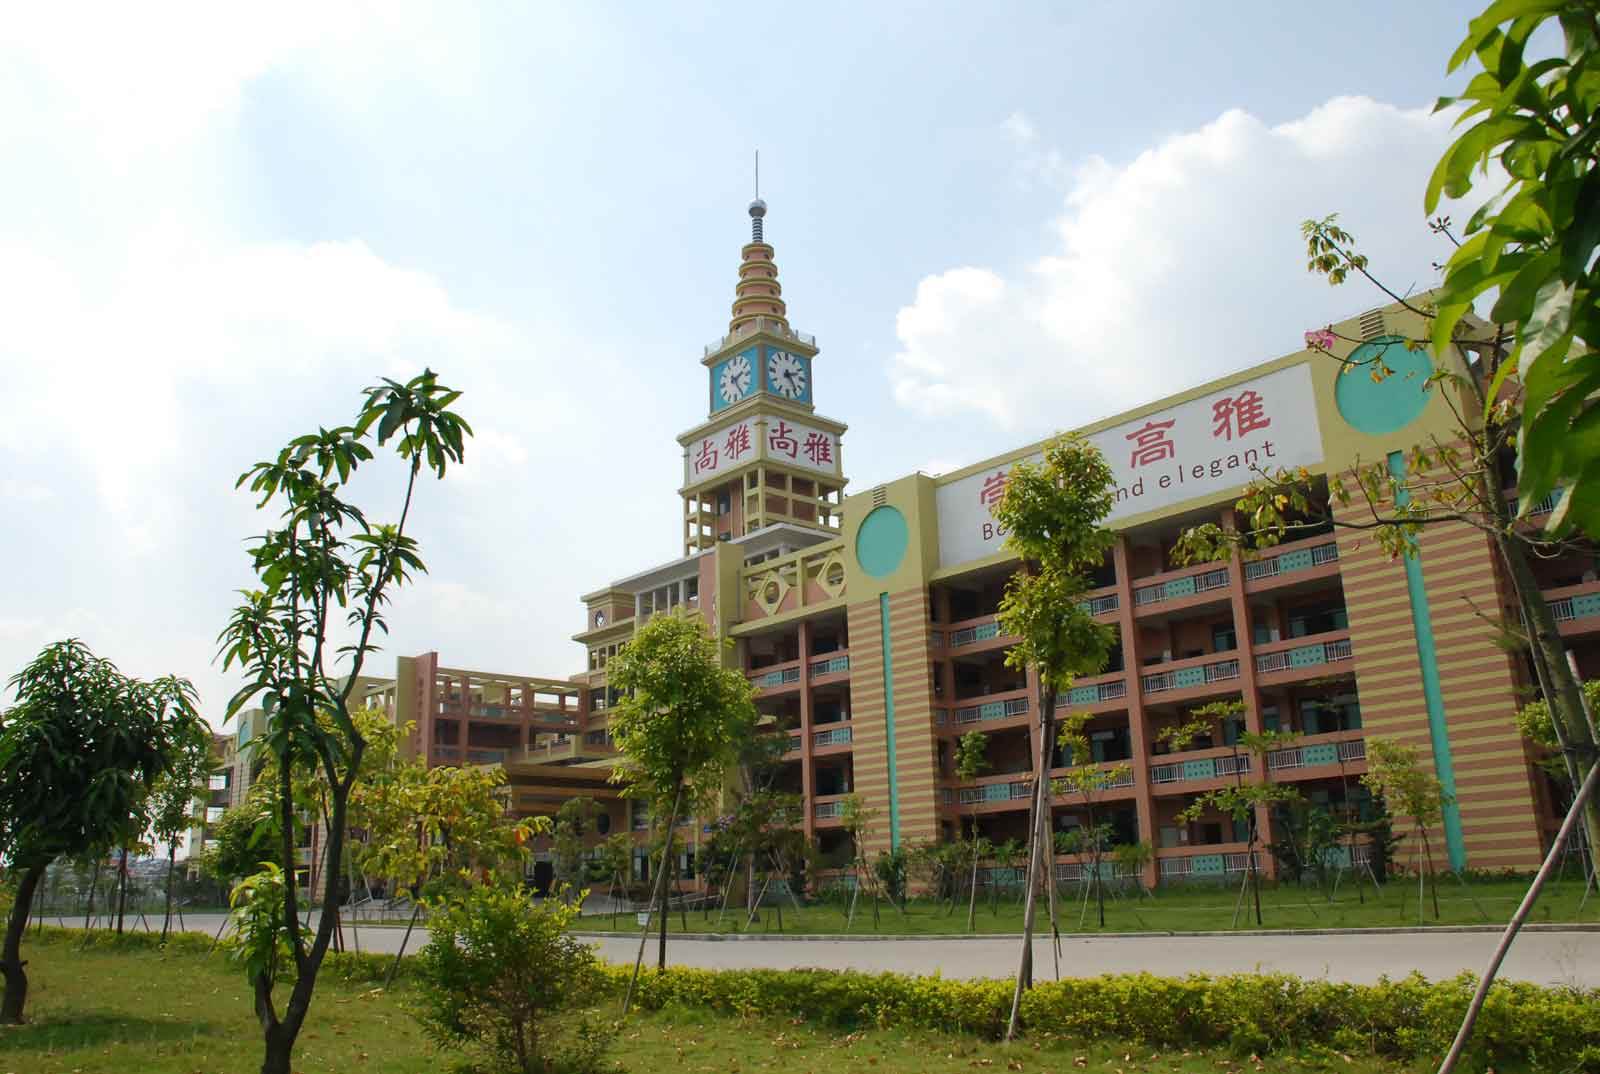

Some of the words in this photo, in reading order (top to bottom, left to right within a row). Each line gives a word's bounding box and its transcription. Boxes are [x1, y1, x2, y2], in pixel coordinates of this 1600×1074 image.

[694, 424, 751, 475] 尚雅
[768, 421, 833, 465] 尚雅
[1158, 440, 1276, 489] elegant
